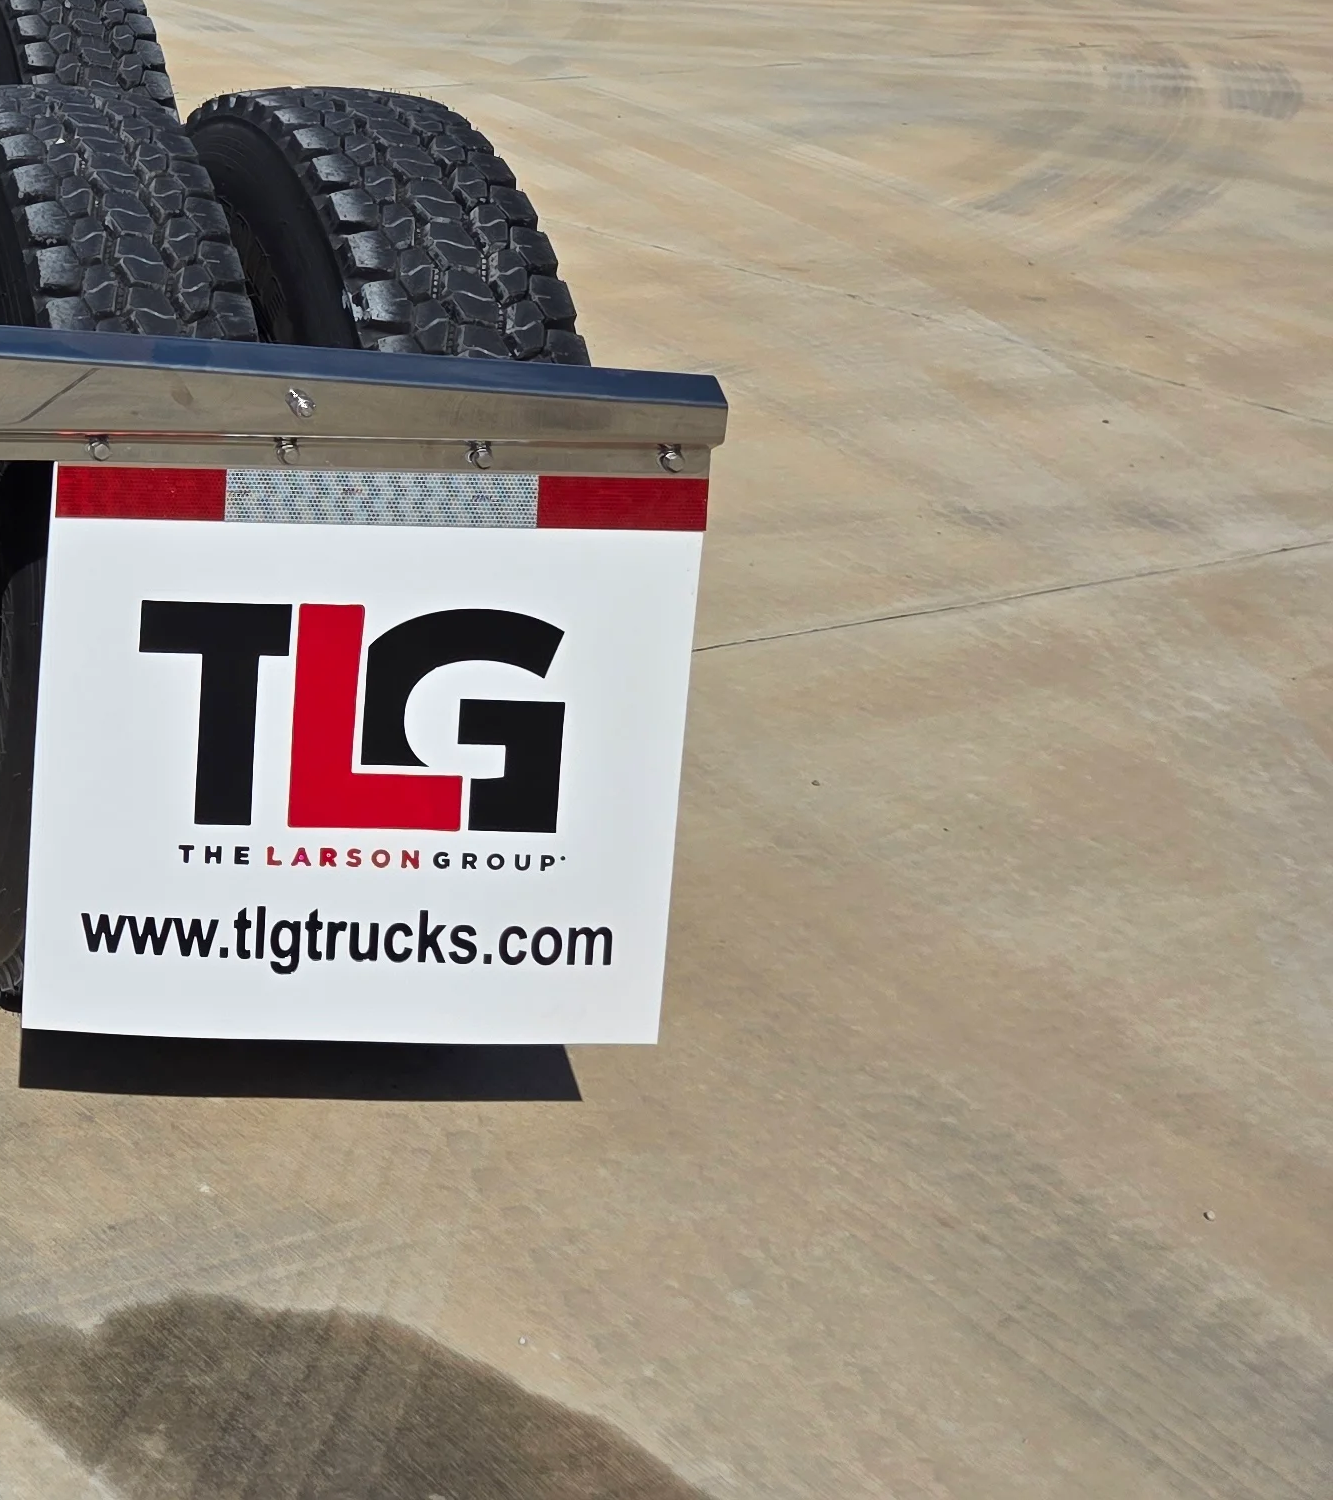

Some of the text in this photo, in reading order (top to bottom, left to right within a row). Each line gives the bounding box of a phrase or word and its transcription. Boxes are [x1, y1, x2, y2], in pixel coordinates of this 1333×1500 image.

[138, 599, 566, 834] TLG
[178, 844, 250, 866] THE
[266, 845, 421, 870] LARSON
[80, 904, 614, 976] www.tlgtrucks.com
